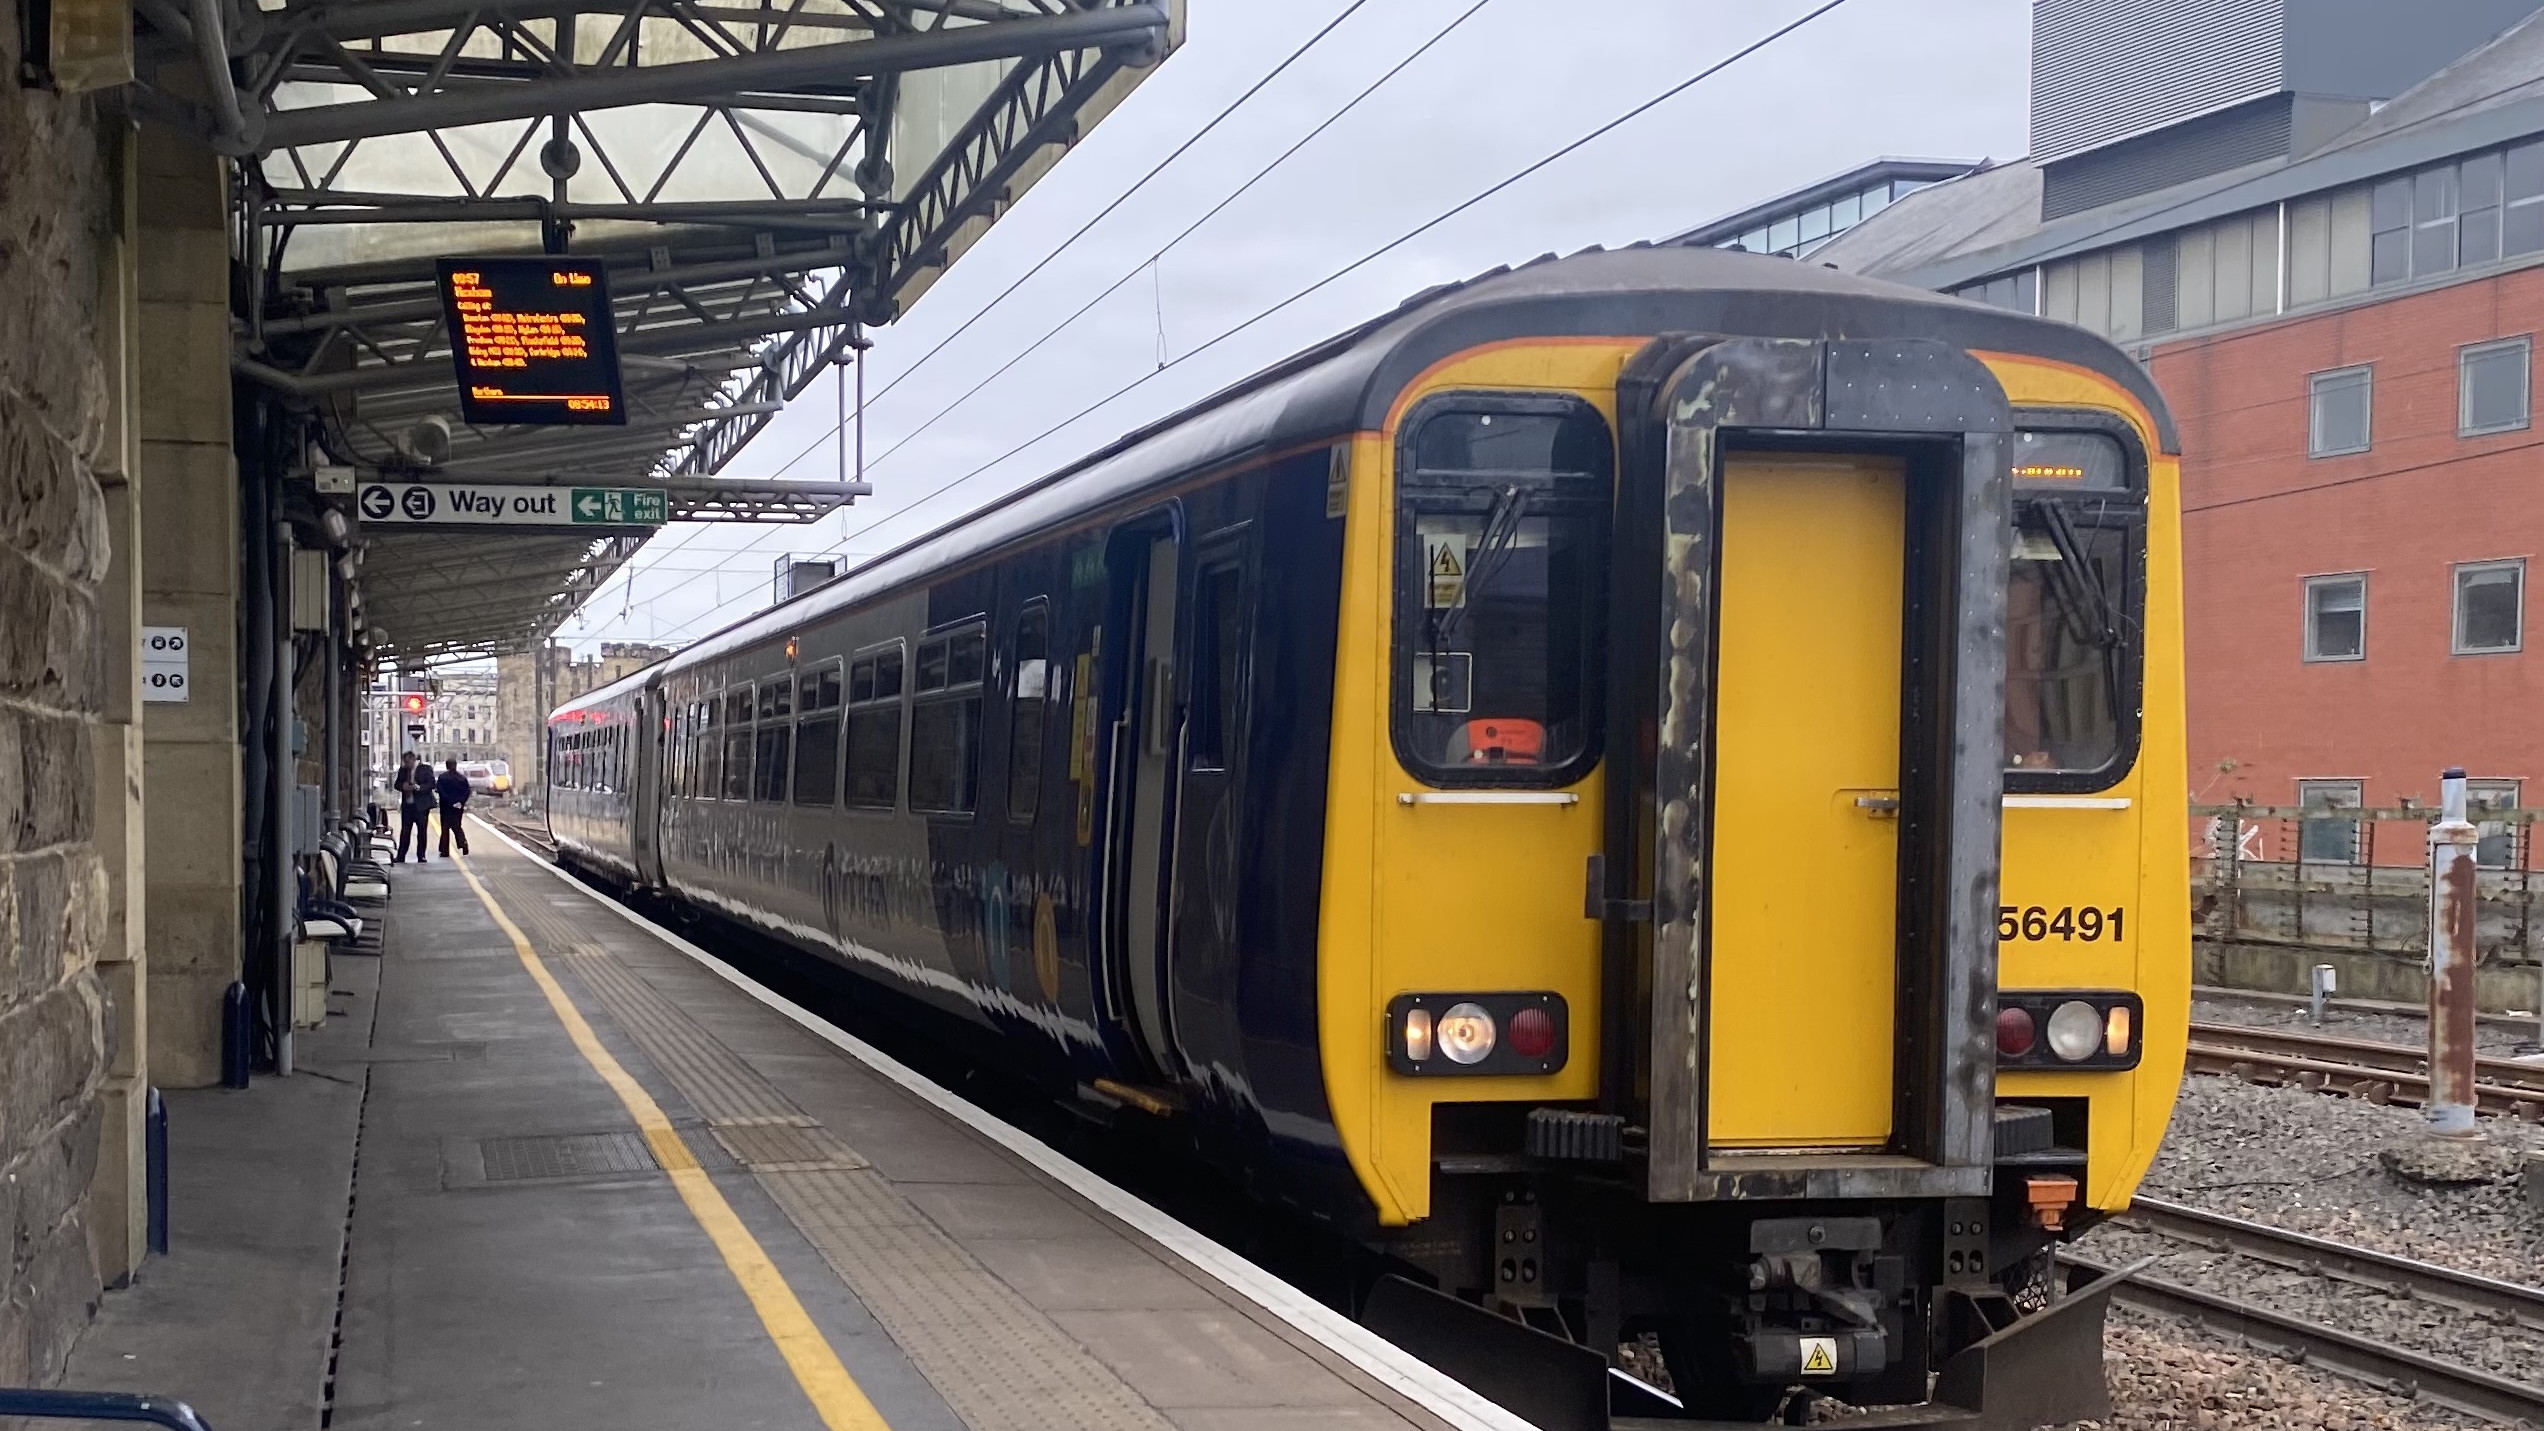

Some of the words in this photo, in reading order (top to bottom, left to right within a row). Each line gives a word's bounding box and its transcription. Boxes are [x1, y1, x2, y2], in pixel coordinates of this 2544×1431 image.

[553, 272, 568, 285] On
[448, 490, 506, 518] Way
[513, 493, 556, 514] out
[633, 492, 661, 506] Fire
[634, 507, 661, 520] exit
[1998, 905, 2124, 942] 56491
